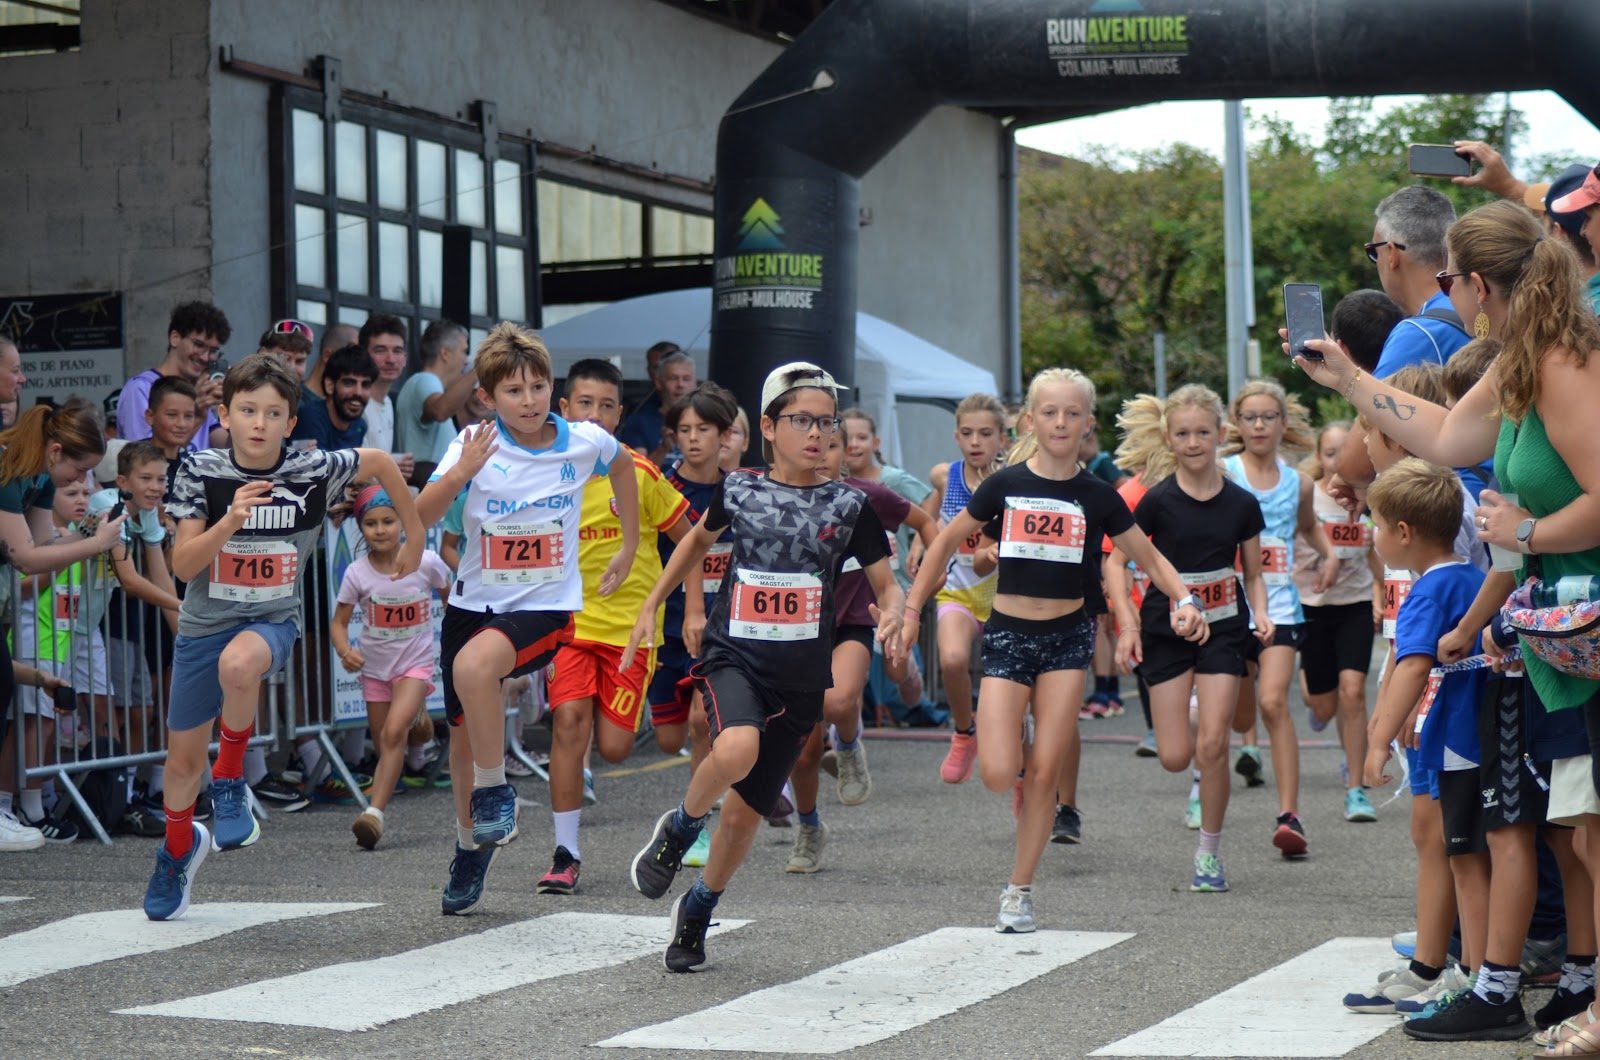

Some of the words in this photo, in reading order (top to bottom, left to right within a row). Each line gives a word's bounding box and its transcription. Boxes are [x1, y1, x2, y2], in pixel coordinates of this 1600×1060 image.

[1046, 16, 1187, 44] RUNAVENTURE
[1058, 58, 1181, 77] COLMAR-MULHOUSE
[22, 362, 37, 372] RS
[41, 361, 55, 371] DE
[60, 359, 94, 371] PIANO
[24, 377, 44, 389] ING
[46, 375, 112, 389] ARTISTIQUE
[227, 505, 296, 530] UMA
[1024, 514, 1064, 537] 624
[1332, 526, 1359, 541] 620
[502, 539, 542, 561] 721
[232, 557, 275, 579] 716
[753, 591, 798, 615] 616
[384, 606, 415, 623] 710
[610, 686, 636, 716] 10
